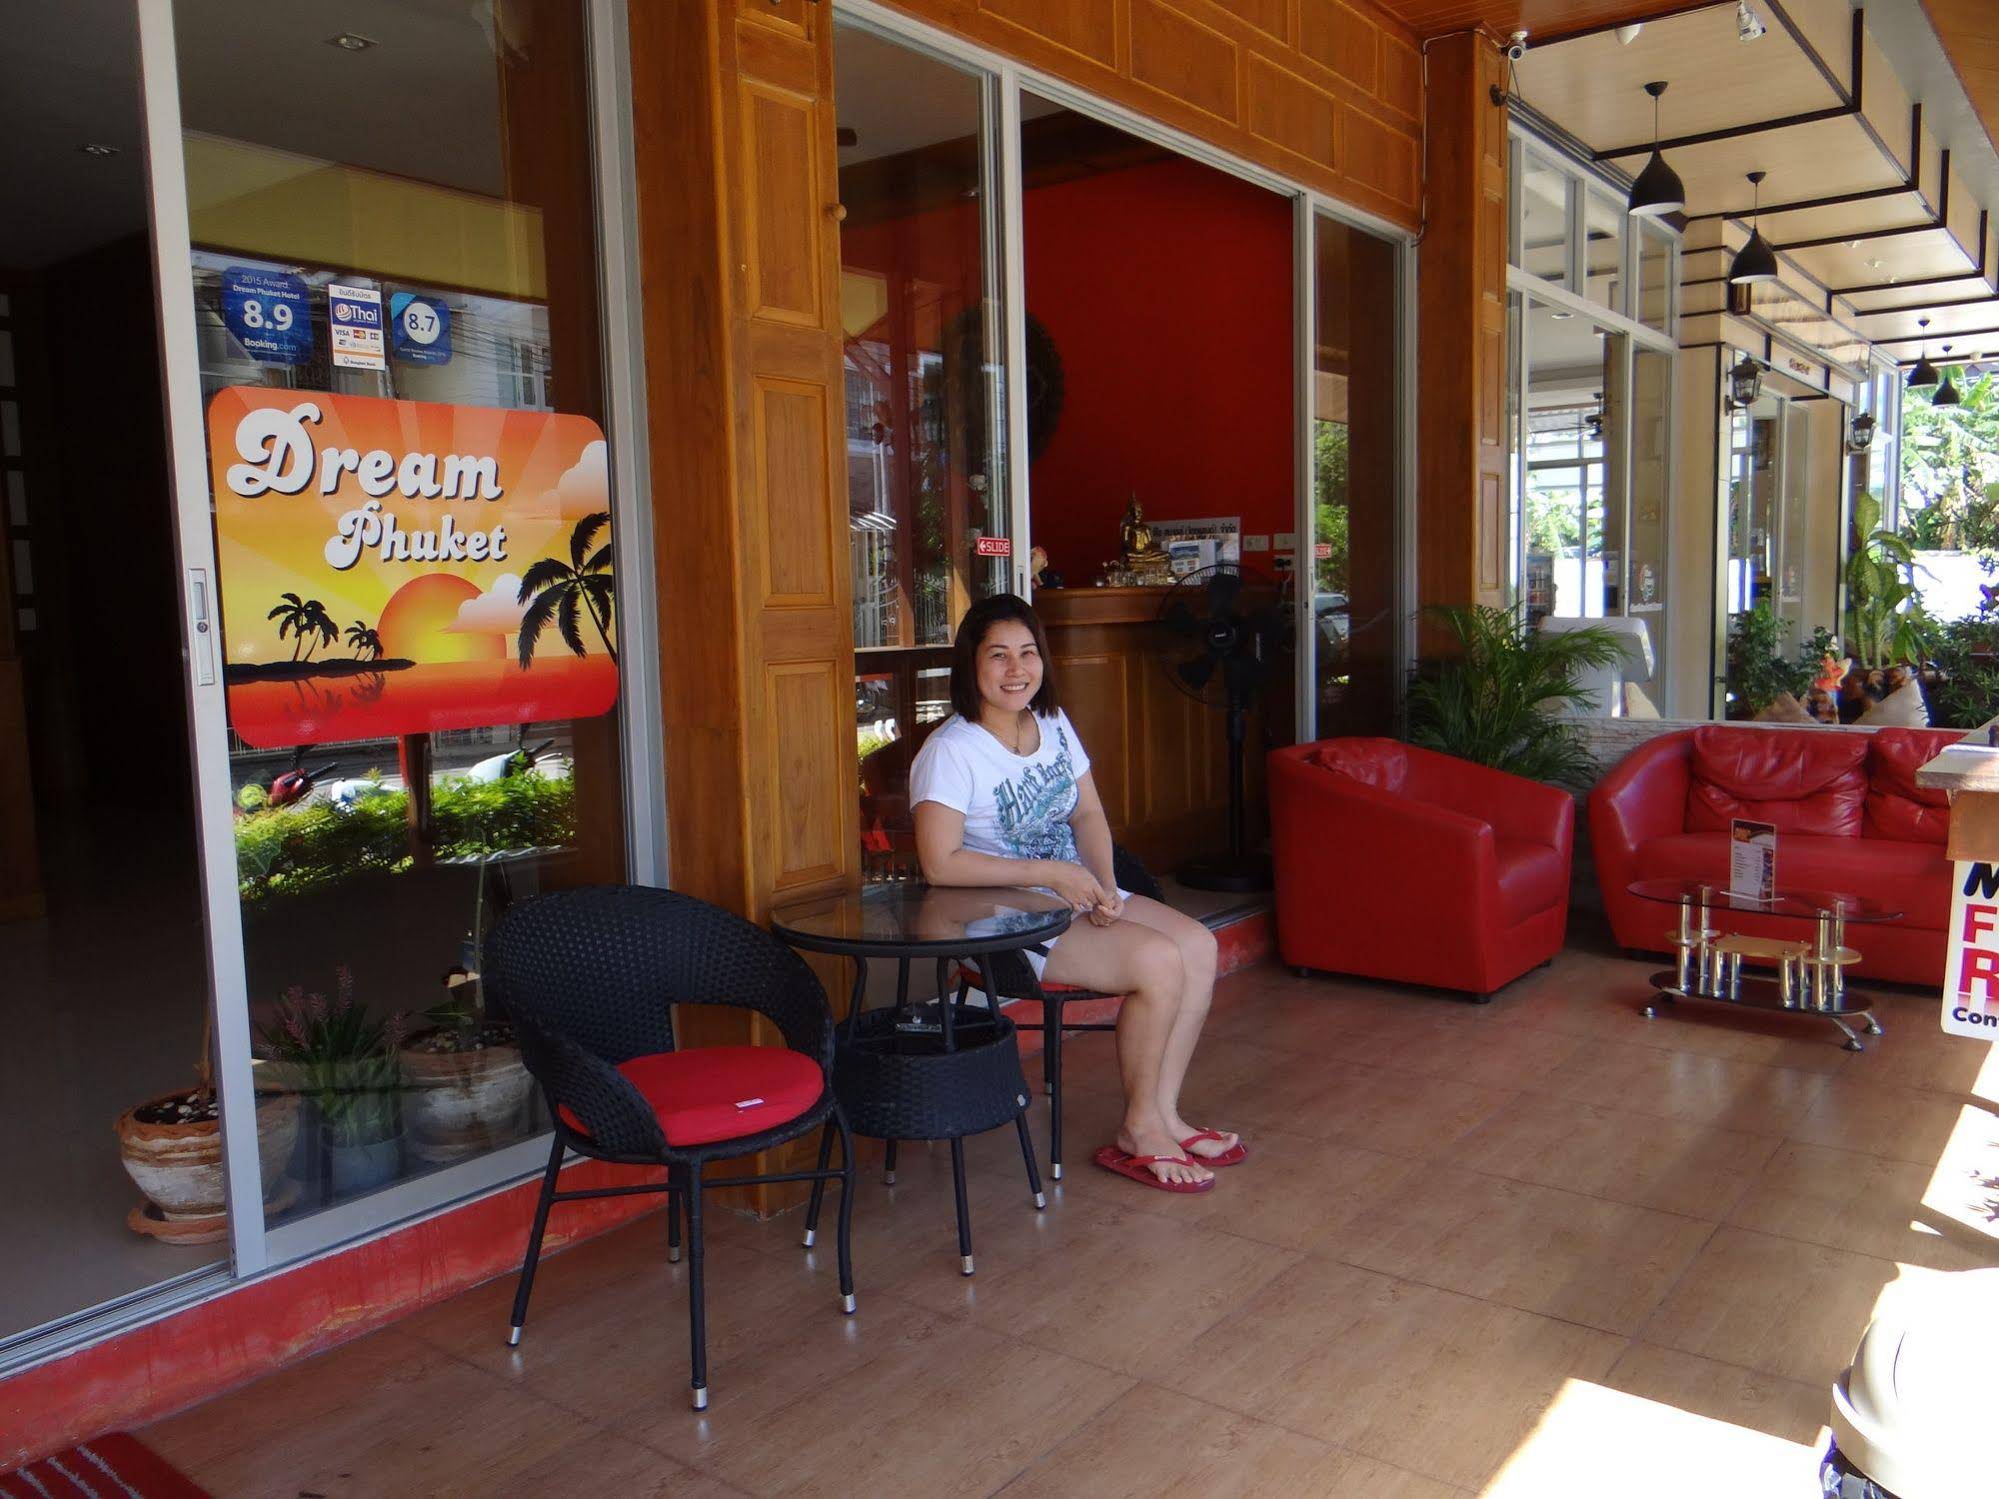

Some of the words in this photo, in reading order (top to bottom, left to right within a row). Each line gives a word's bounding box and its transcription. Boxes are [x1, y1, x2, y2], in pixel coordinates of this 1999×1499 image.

[241, 275, 262, 286] 2015
[233, 284, 256, 294] Dream
[257, 288, 281, 298] Phuket
[282, 291, 301, 300] Hotel
[243, 300, 293, 331] 8.9
[350, 305, 378, 323] Thai
[409, 313, 435, 332] 8.7
[335, 329, 350, 337] VISA
[244, 337, 297, 351] Booking.com
[226, 402, 503, 499] Dream
[324, 500, 508, 570] Phuket
[986, 541, 1009, 553] SLIDE
[1952, 1006, 1999, 1028] Con
